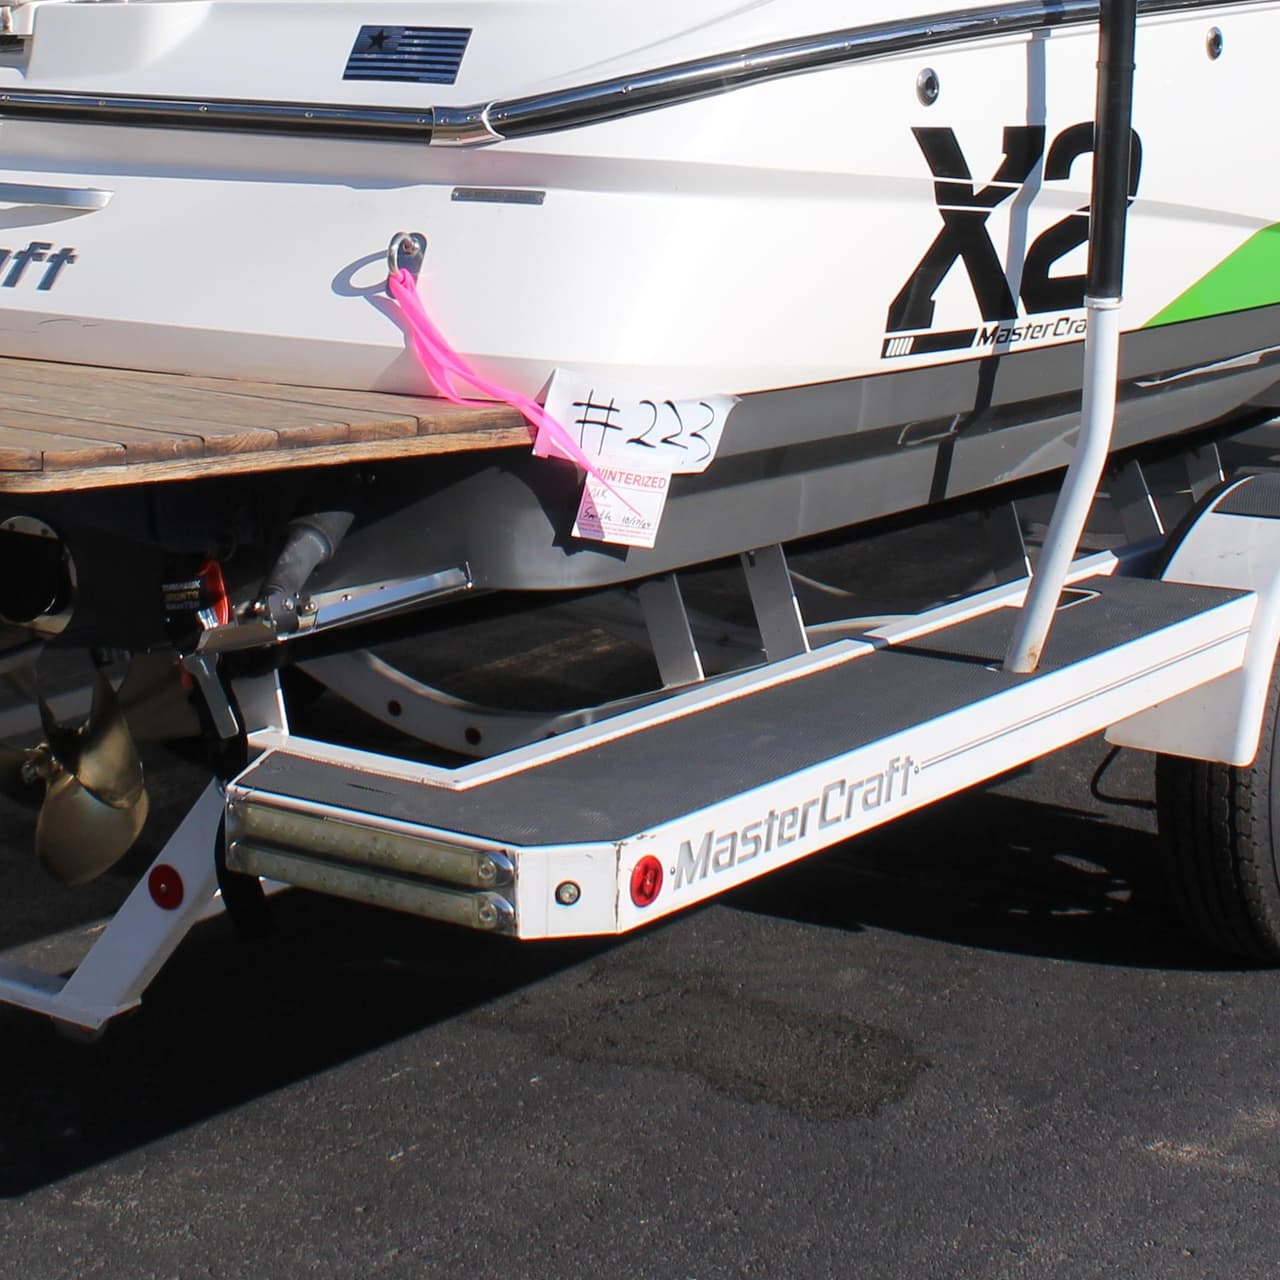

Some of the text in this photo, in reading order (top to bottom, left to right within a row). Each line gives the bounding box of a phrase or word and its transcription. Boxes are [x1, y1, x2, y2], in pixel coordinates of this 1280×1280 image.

[884, 120, 1143, 333] X2
[570, 388, 717, 463] #223
[673, 754, 914, 891] MasterCraft
